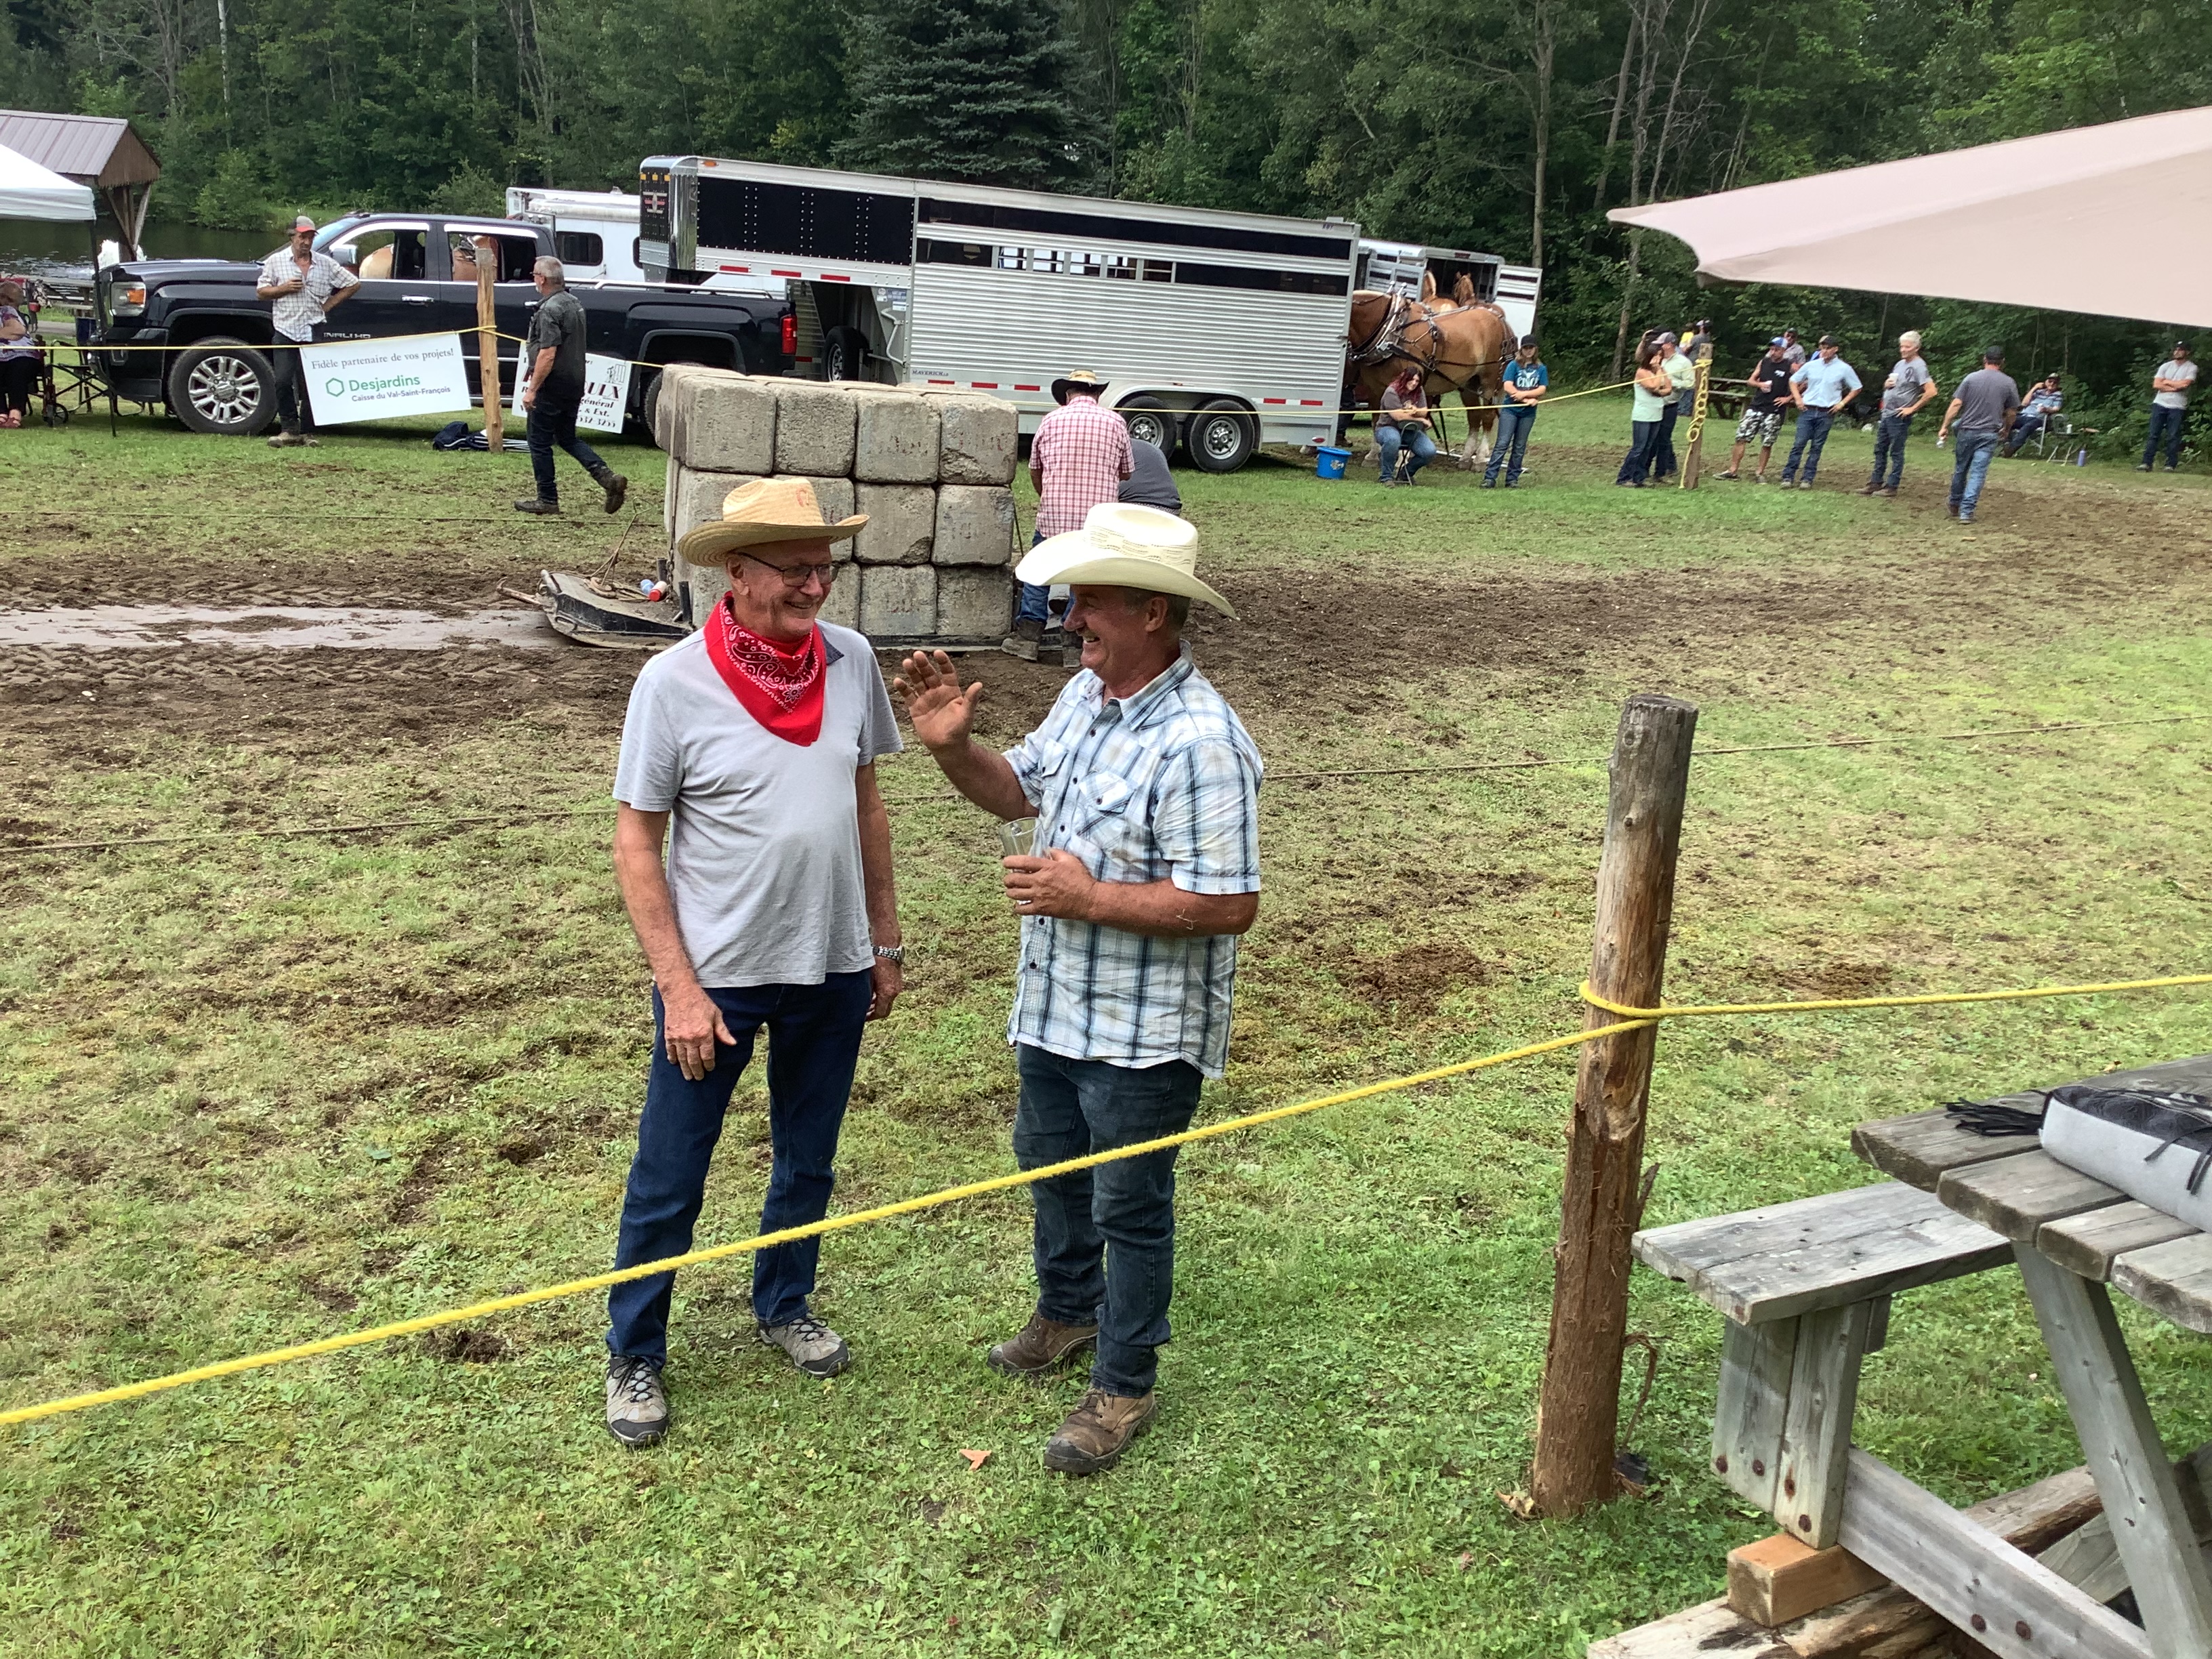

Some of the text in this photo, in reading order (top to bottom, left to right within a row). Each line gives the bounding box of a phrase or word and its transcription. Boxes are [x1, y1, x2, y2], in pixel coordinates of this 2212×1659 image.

[311, 360, 339, 369] Fidèle
[341, 354, 388, 369] partenaire
[391, 353, 402, 362] de
[422, 348, 455, 361] projets!
[348, 375, 421, 392] Desjardins
[352, 393, 375, 402] Caisse
[387, 386, 451, 398] Val-Saint-François
